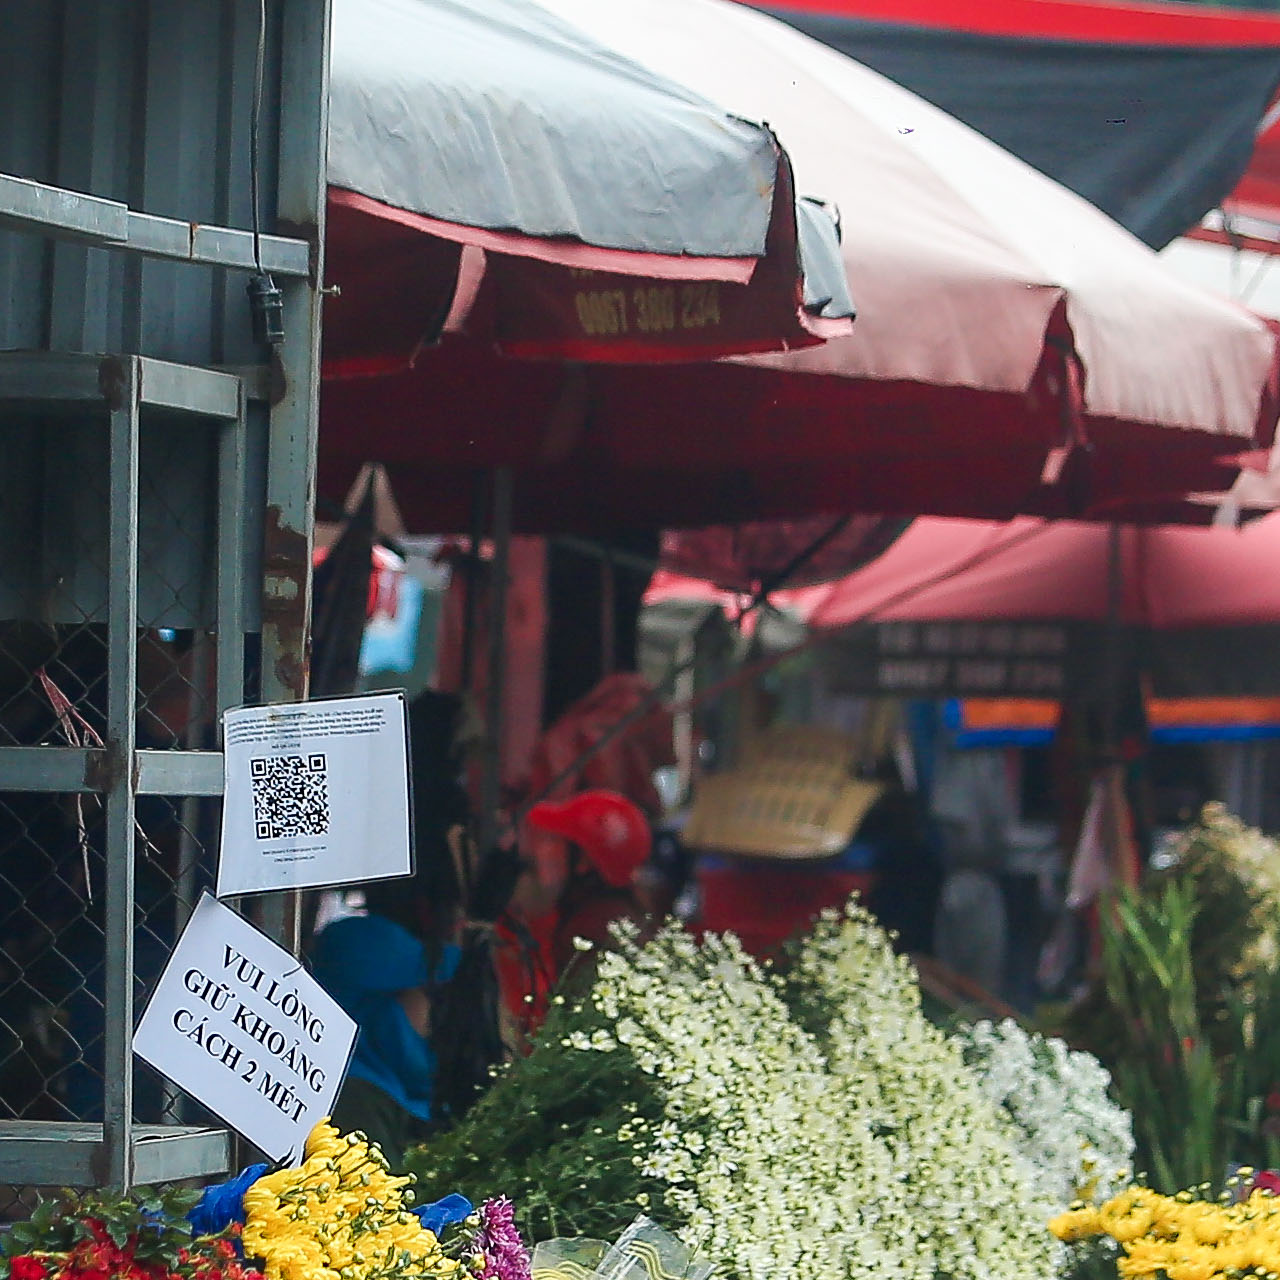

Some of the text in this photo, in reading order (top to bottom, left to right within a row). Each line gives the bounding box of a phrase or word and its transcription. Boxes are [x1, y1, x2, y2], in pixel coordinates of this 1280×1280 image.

[184, 969, 326, 1093] GIỮ KHOẢNG
[223, 944, 325, 1043] VUI LÒNG
[173, 1009, 308, 1123] CÁCH 2 MÉT
